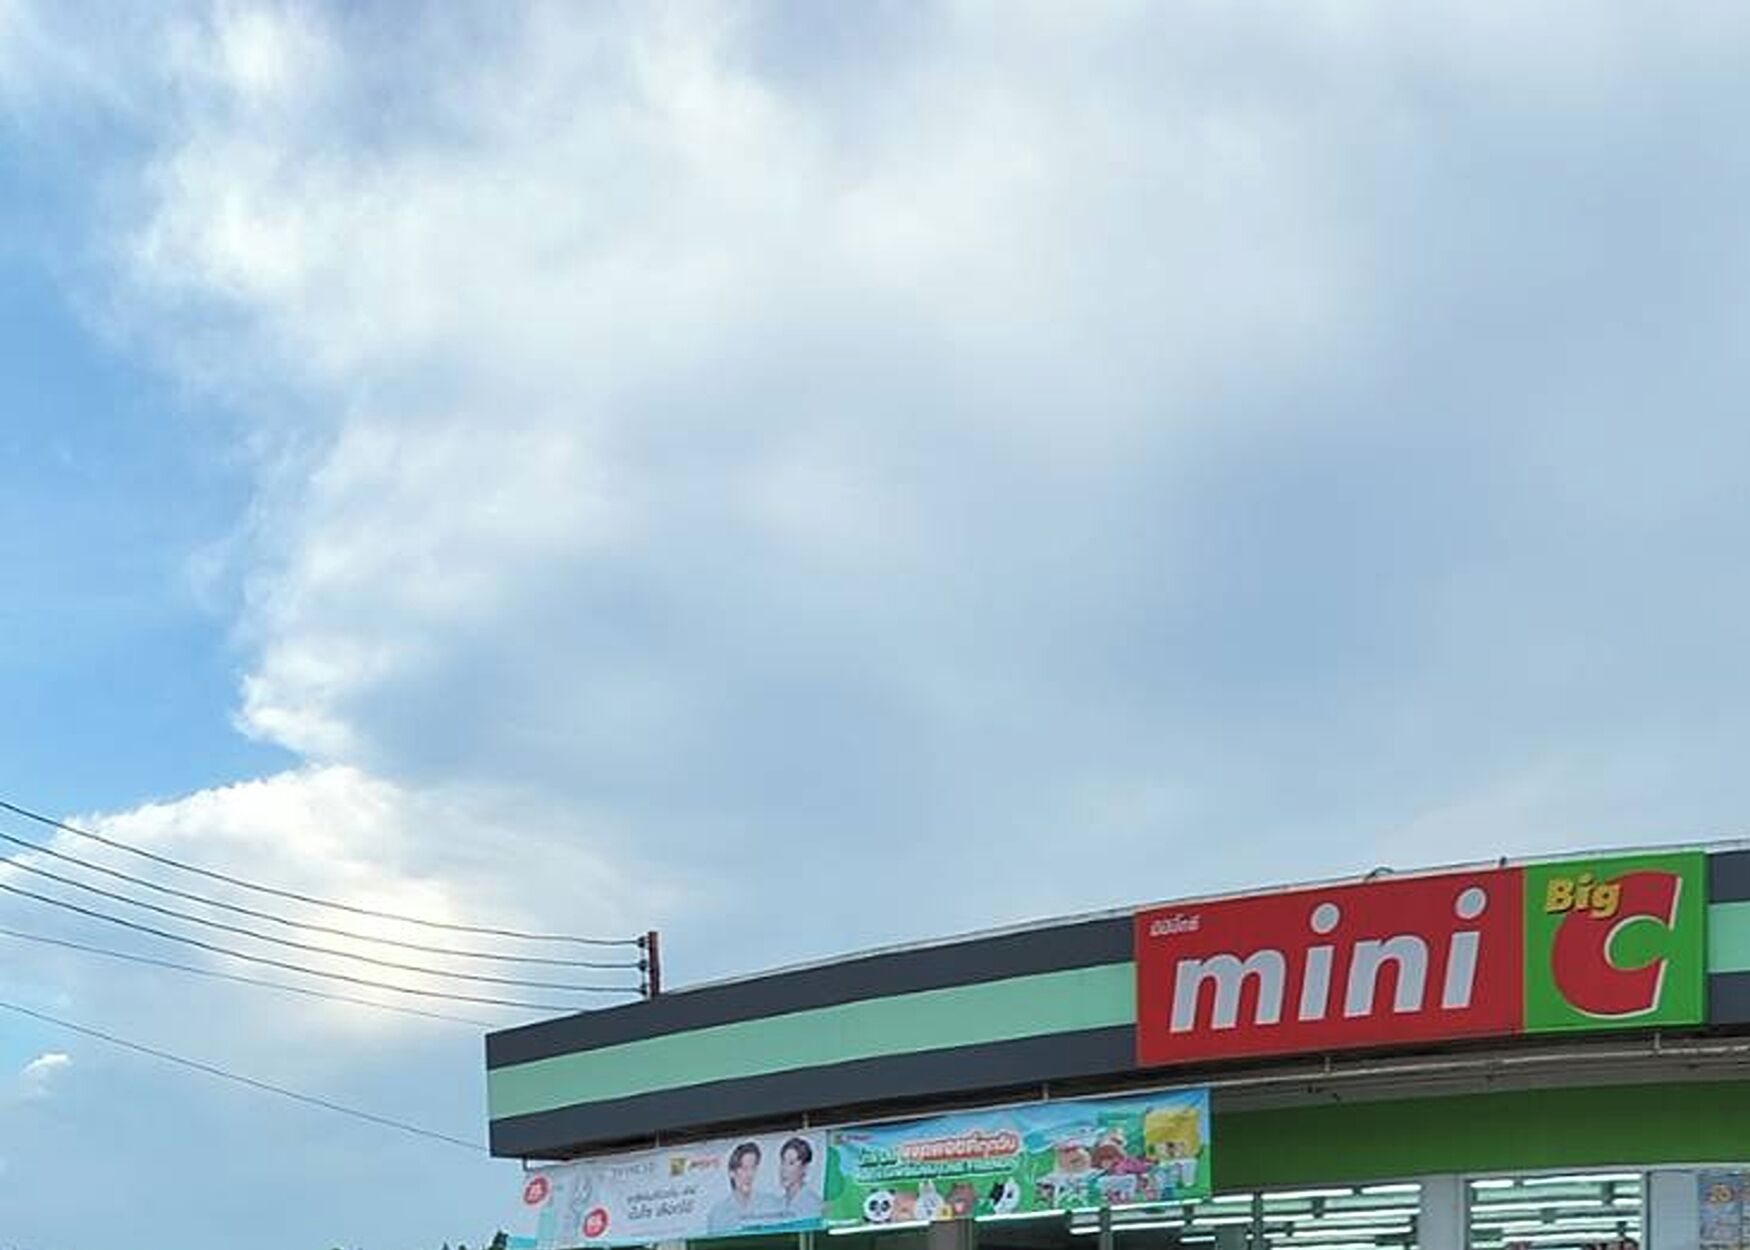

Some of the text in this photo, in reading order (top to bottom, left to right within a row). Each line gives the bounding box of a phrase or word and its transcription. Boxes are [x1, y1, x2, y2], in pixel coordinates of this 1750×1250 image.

[1169, 886, 1487, 1033] mini
[1543, 874, 1622, 918] Big
[1550, 869, 1683, 1018] C
